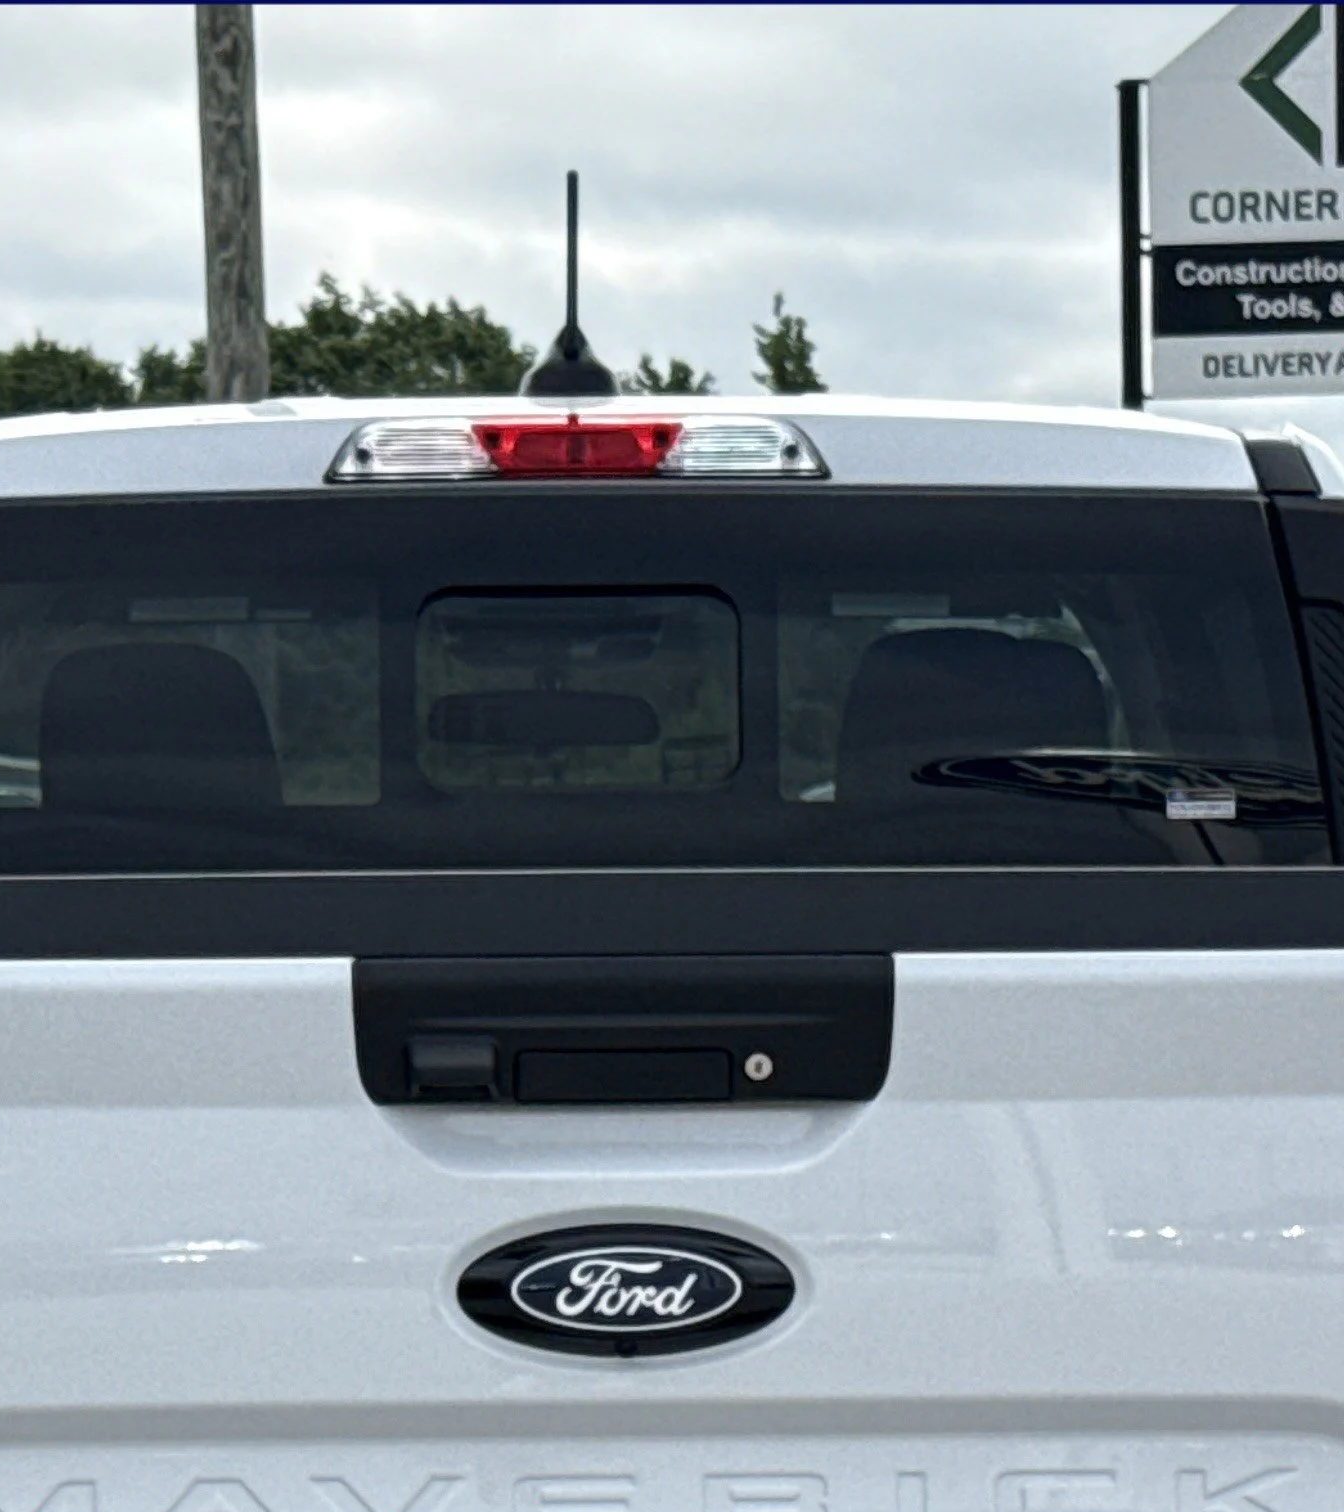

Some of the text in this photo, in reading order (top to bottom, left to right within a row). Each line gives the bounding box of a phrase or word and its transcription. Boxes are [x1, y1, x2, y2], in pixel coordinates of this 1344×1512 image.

[1189, 188, 1340, 224] CORNER
[1235, 292, 1322, 322] Tools,
[1202, 351, 1334, 379] DELIVERY
[556, 1258, 699, 1316] Ford
